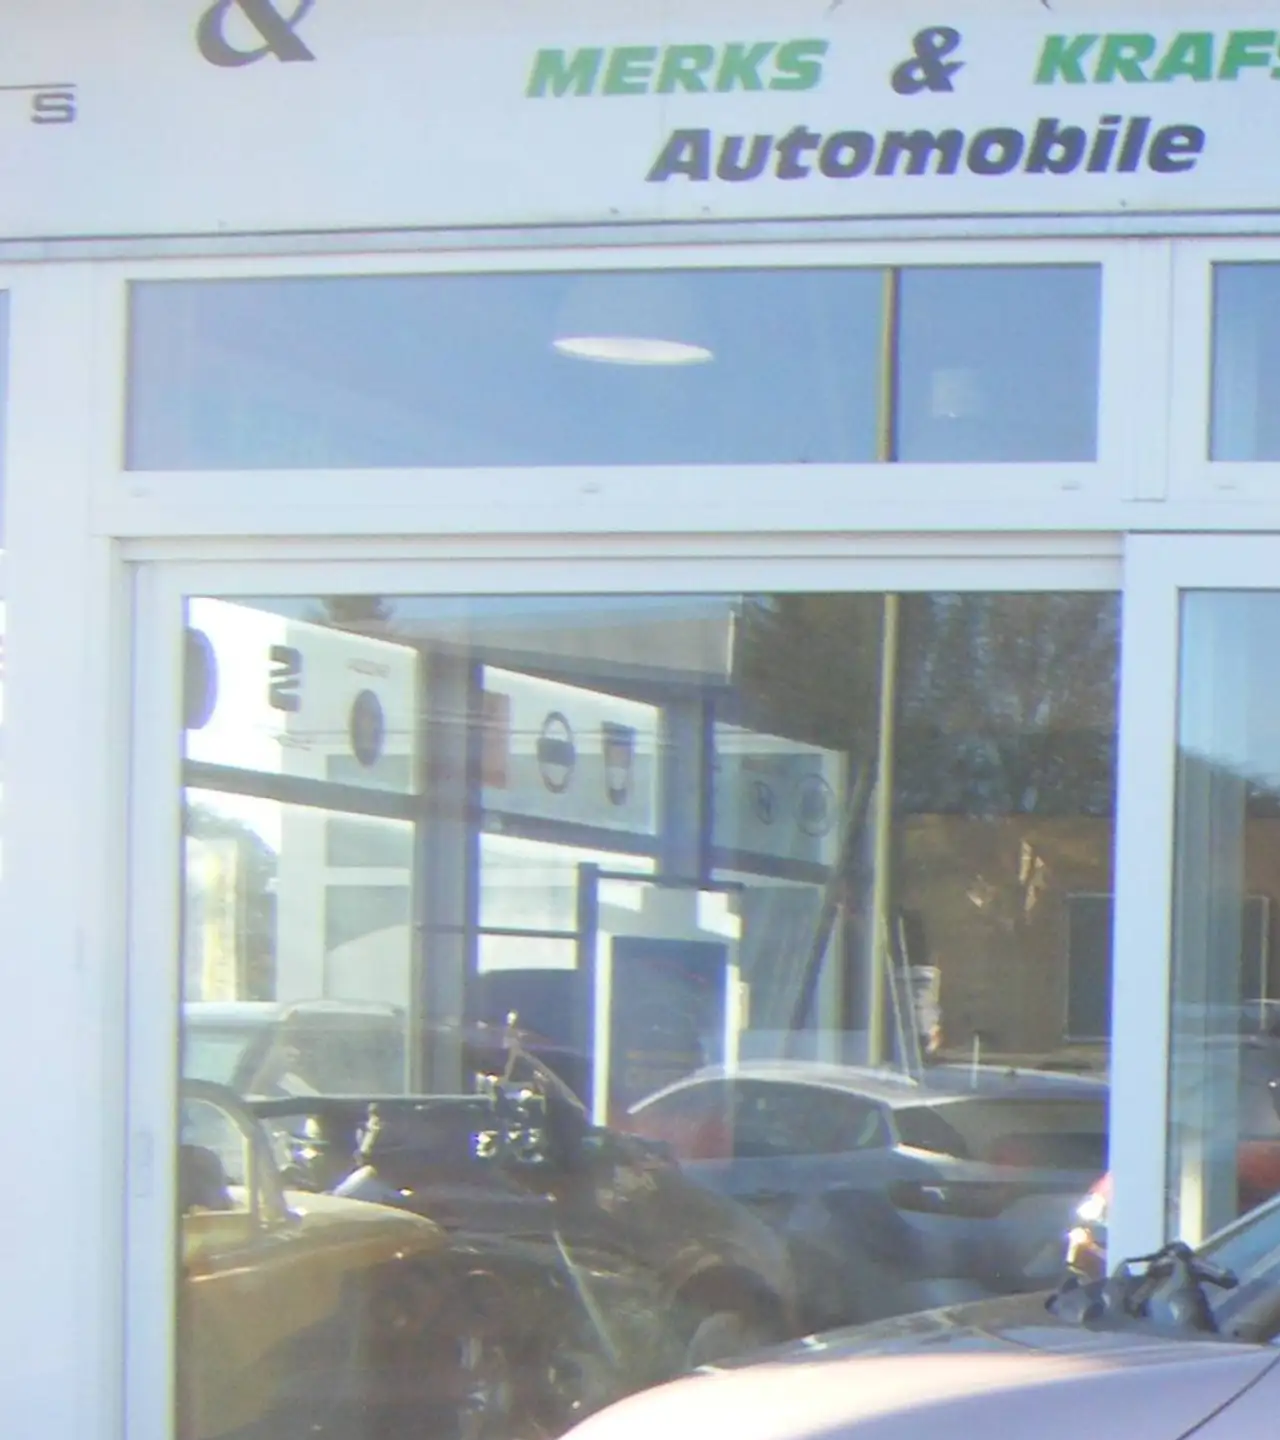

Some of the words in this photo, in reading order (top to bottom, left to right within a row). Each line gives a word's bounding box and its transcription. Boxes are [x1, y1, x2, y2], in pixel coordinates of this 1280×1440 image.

[525, 38, 830, 98] MERKS
[890, 25, 966, 95] &
[645, 115, 1206, 183] Automobile
